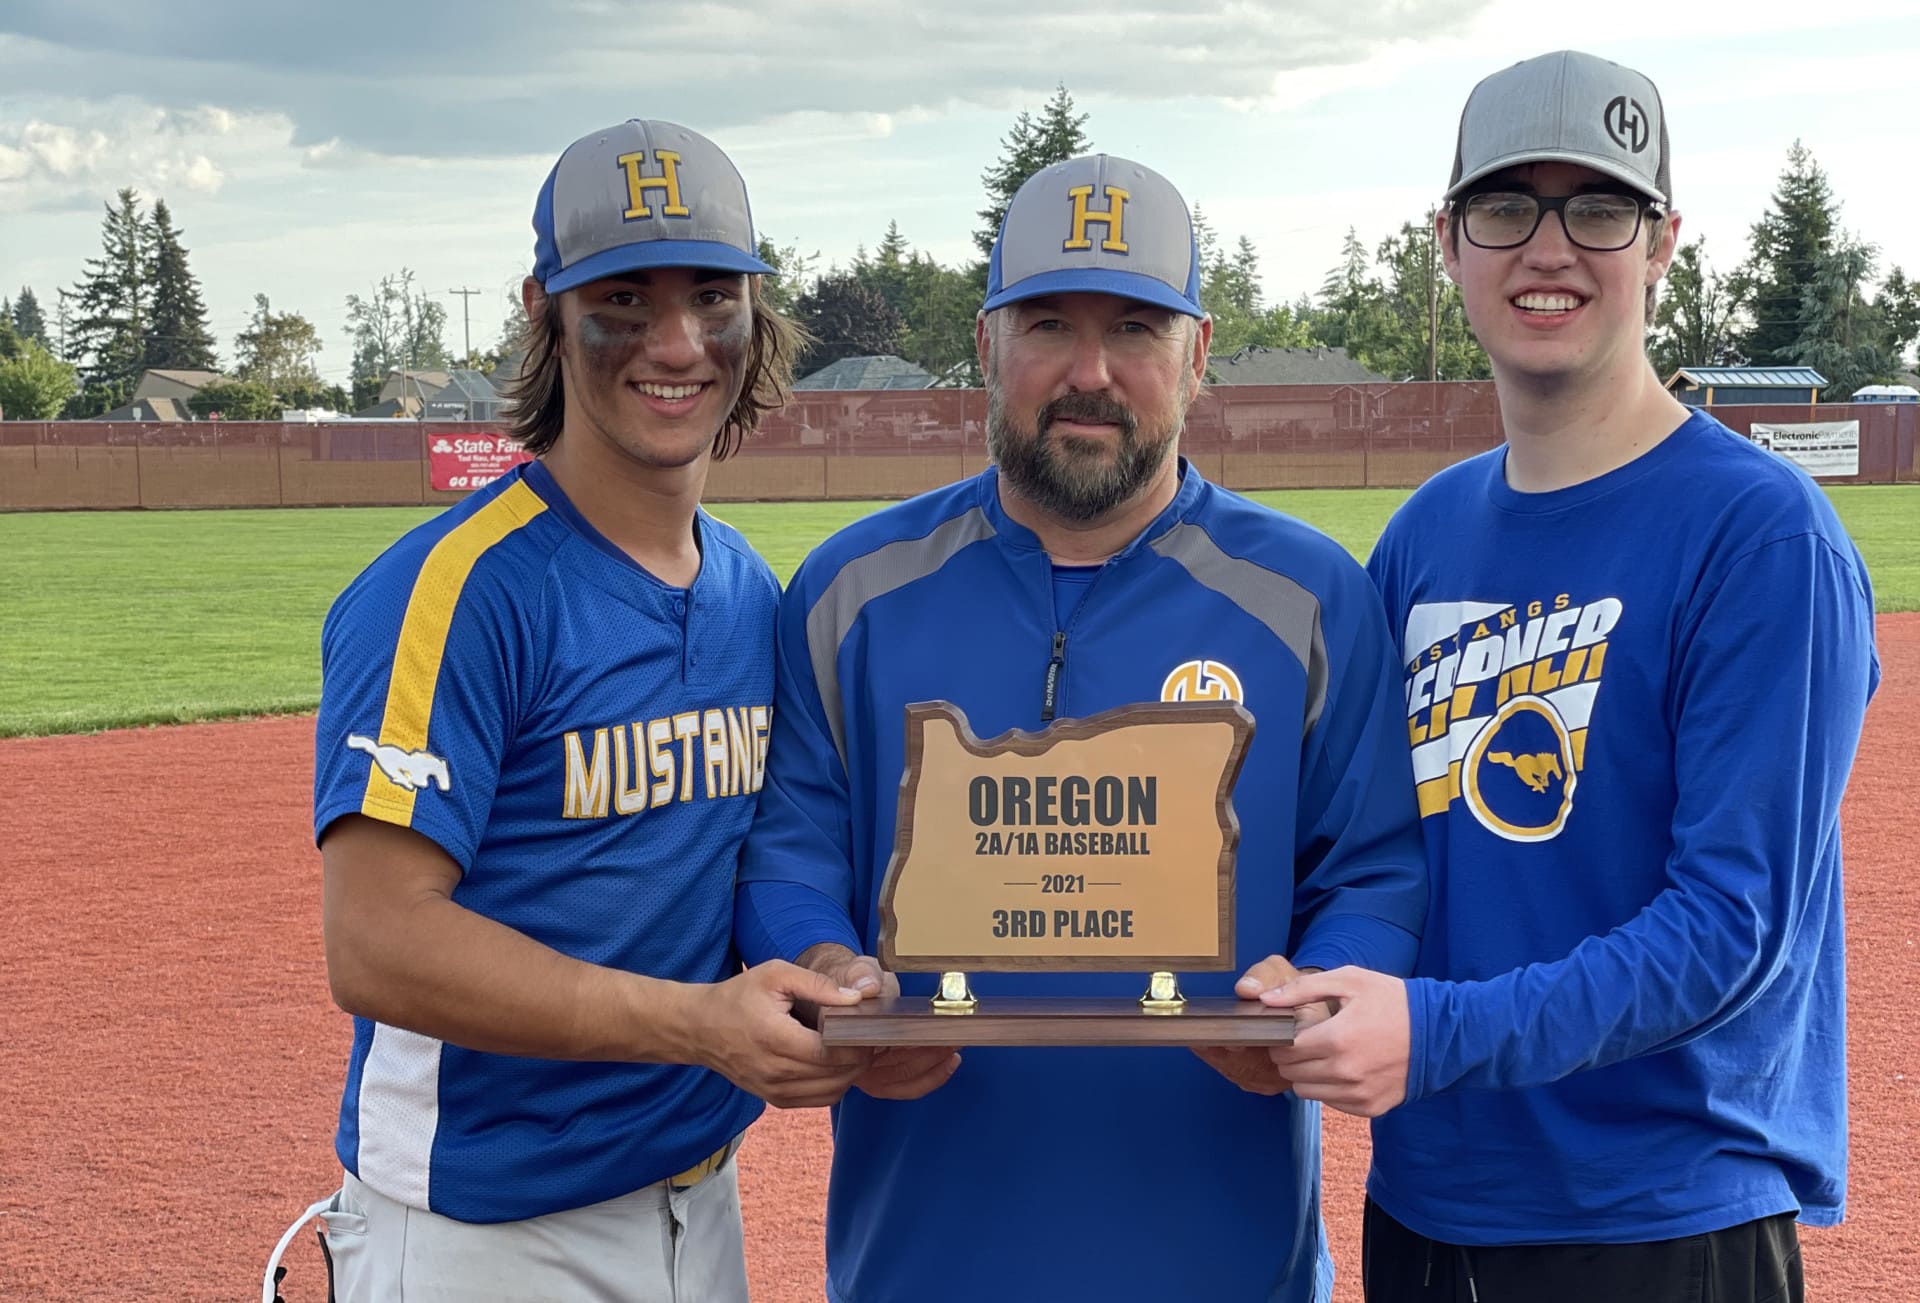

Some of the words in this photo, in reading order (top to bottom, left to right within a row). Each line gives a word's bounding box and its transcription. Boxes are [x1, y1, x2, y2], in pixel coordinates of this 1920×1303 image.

[617, 149, 691, 223] H
[1062, 184, 1130, 256] H
[454, 439, 493, 453] State
[496, 439, 524, 453] Far
[449, 476, 468, 487] GO
[471, 477, 500, 487] EA
[562, 706, 773, 819] MUSTANG
[969, 776, 1157, 826] OREGON
[975, 832, 1039, 856] 2A/1A
[1045, 832, 1150, 856] BASEBALL
[1041, 874, 1084, 893] 2021
[992, 910, 1046, 938] 3RD
[1054, 910, 1133, 938] PLACE
